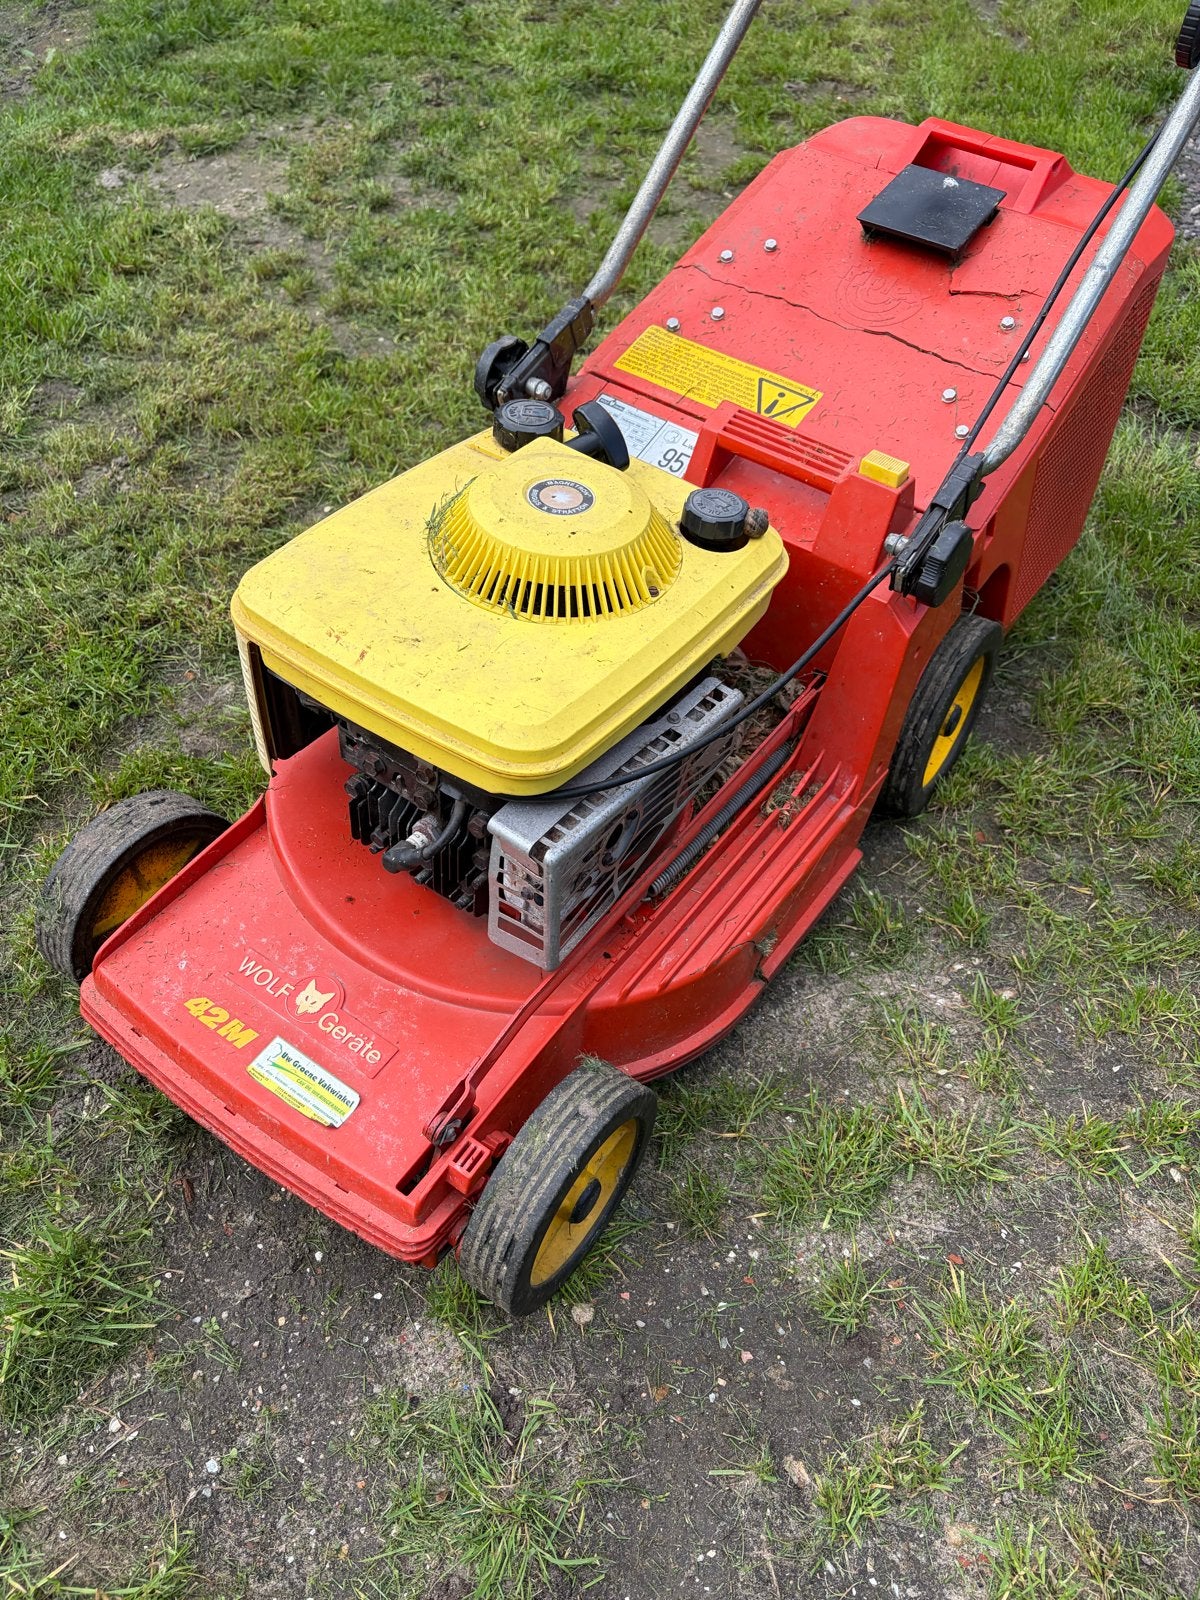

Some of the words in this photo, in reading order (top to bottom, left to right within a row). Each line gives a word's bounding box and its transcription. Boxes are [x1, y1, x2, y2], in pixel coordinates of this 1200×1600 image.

[657, 448, 691, 473] 95
[183, 995, 260, 1050] 42M
[238, 956, 295, 999] WOLF
[317, 1011, 382, 1066] Geräte
[281, 1051, 293, 1063] Uw
[292, 1060, 319, 1082] Groene
[317, 1077, 355, 1108] Vakwinkel
